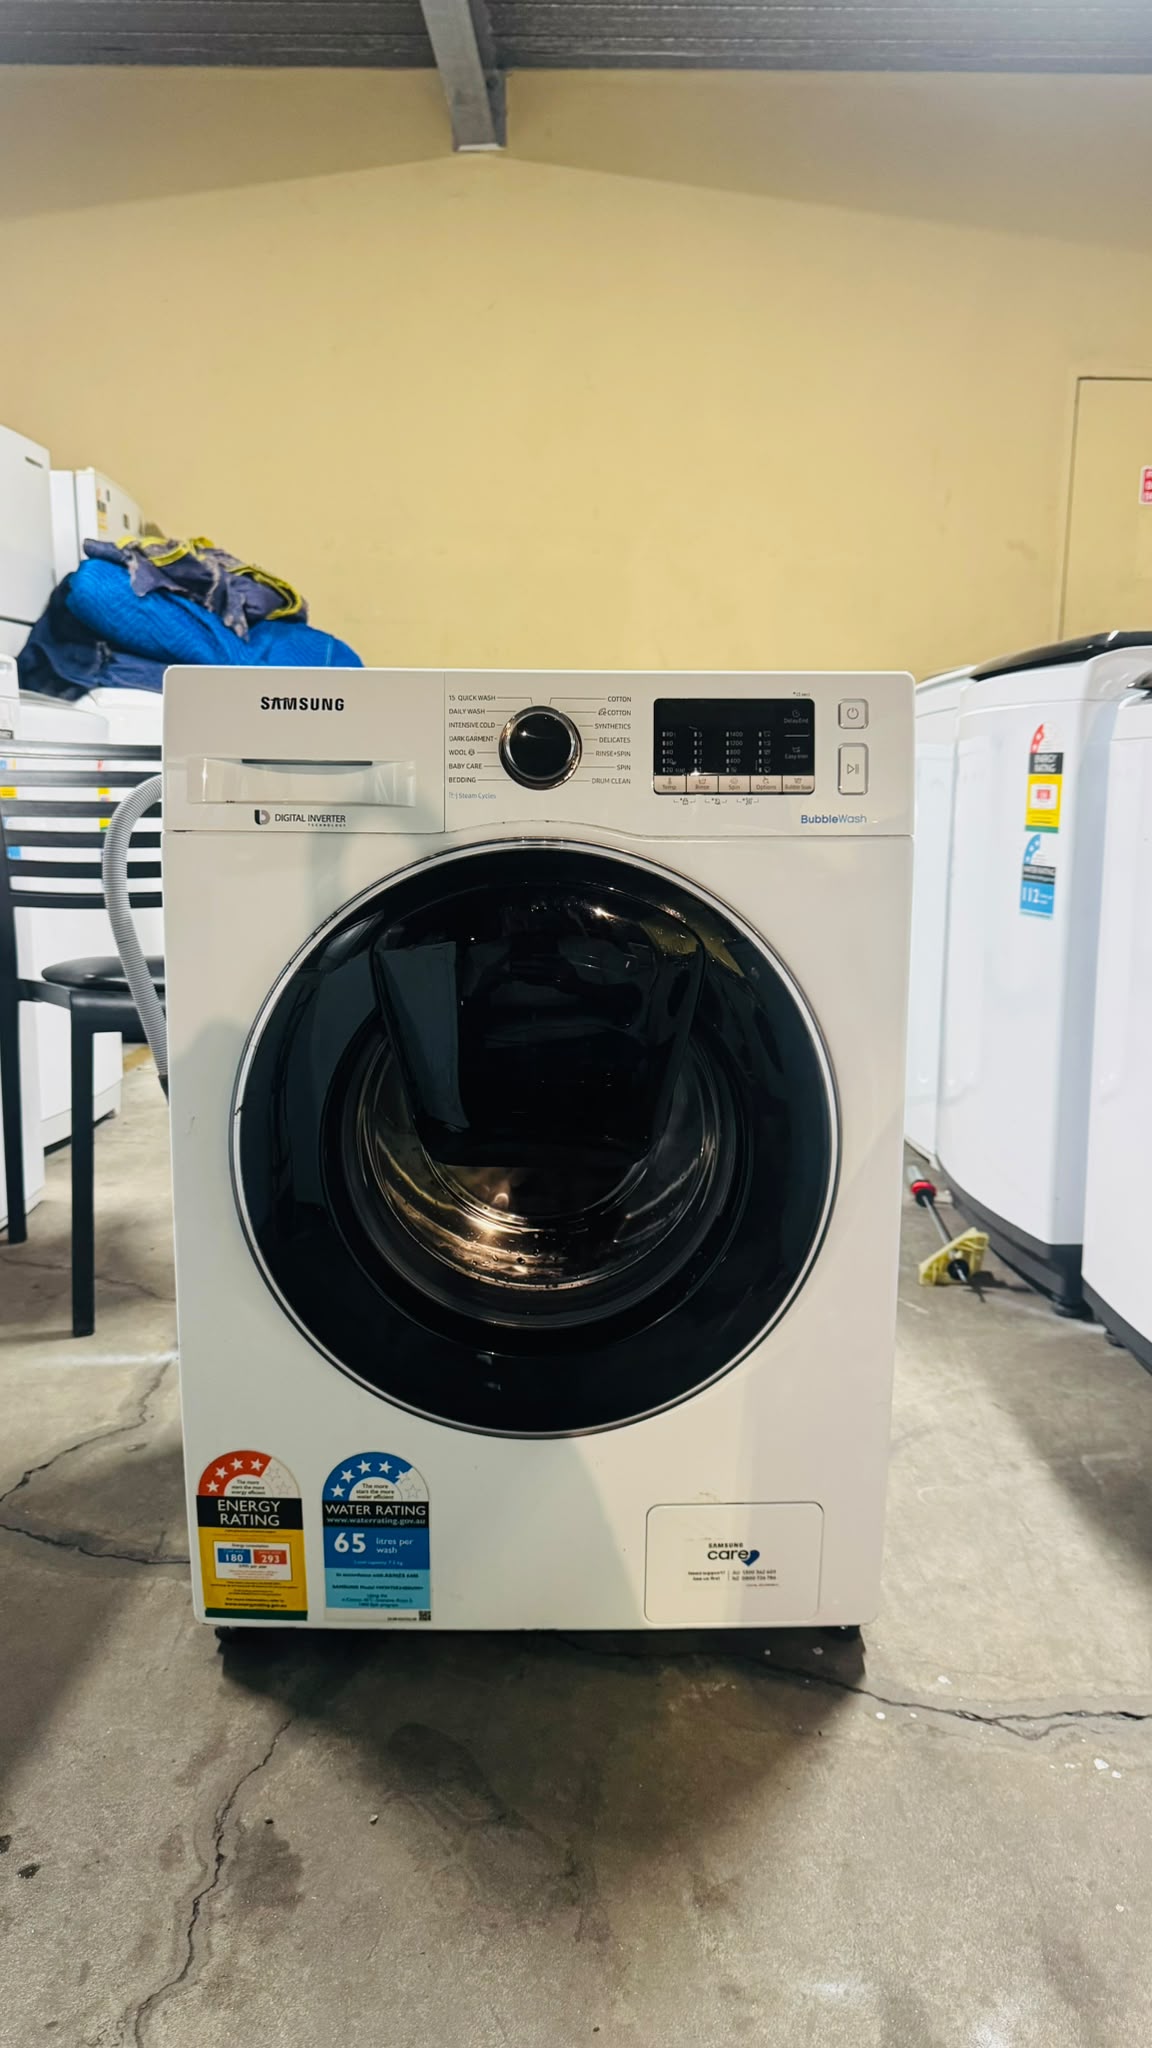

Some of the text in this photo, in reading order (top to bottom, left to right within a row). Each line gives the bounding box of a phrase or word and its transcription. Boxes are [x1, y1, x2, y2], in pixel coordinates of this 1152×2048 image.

[261, 696, 345, 711] SAMSUNG
[478, 792, 497, 800] Cycles
[275, 813, 346, 823] DIGITAL INVERTER
[801, 814, 867, 824] BubbleWash
[1022, 886, 1039, 904] 112
[218, 1499, 280, 1512] ENERGY
[325, 1504, 426, 1516] WATER RATING
[220, 1513, 280, 1526] RATING
[327, 1517, 425, 1526] www.waterrating.gov.au
[334, 1532, 366, 1553] 65
[376, 1537, 414, 1547] litres per
[225, 1554, 243, 1562] 180
[261, 1555, 280, 1563] 293
[707, 1549, 749, 1560] care
